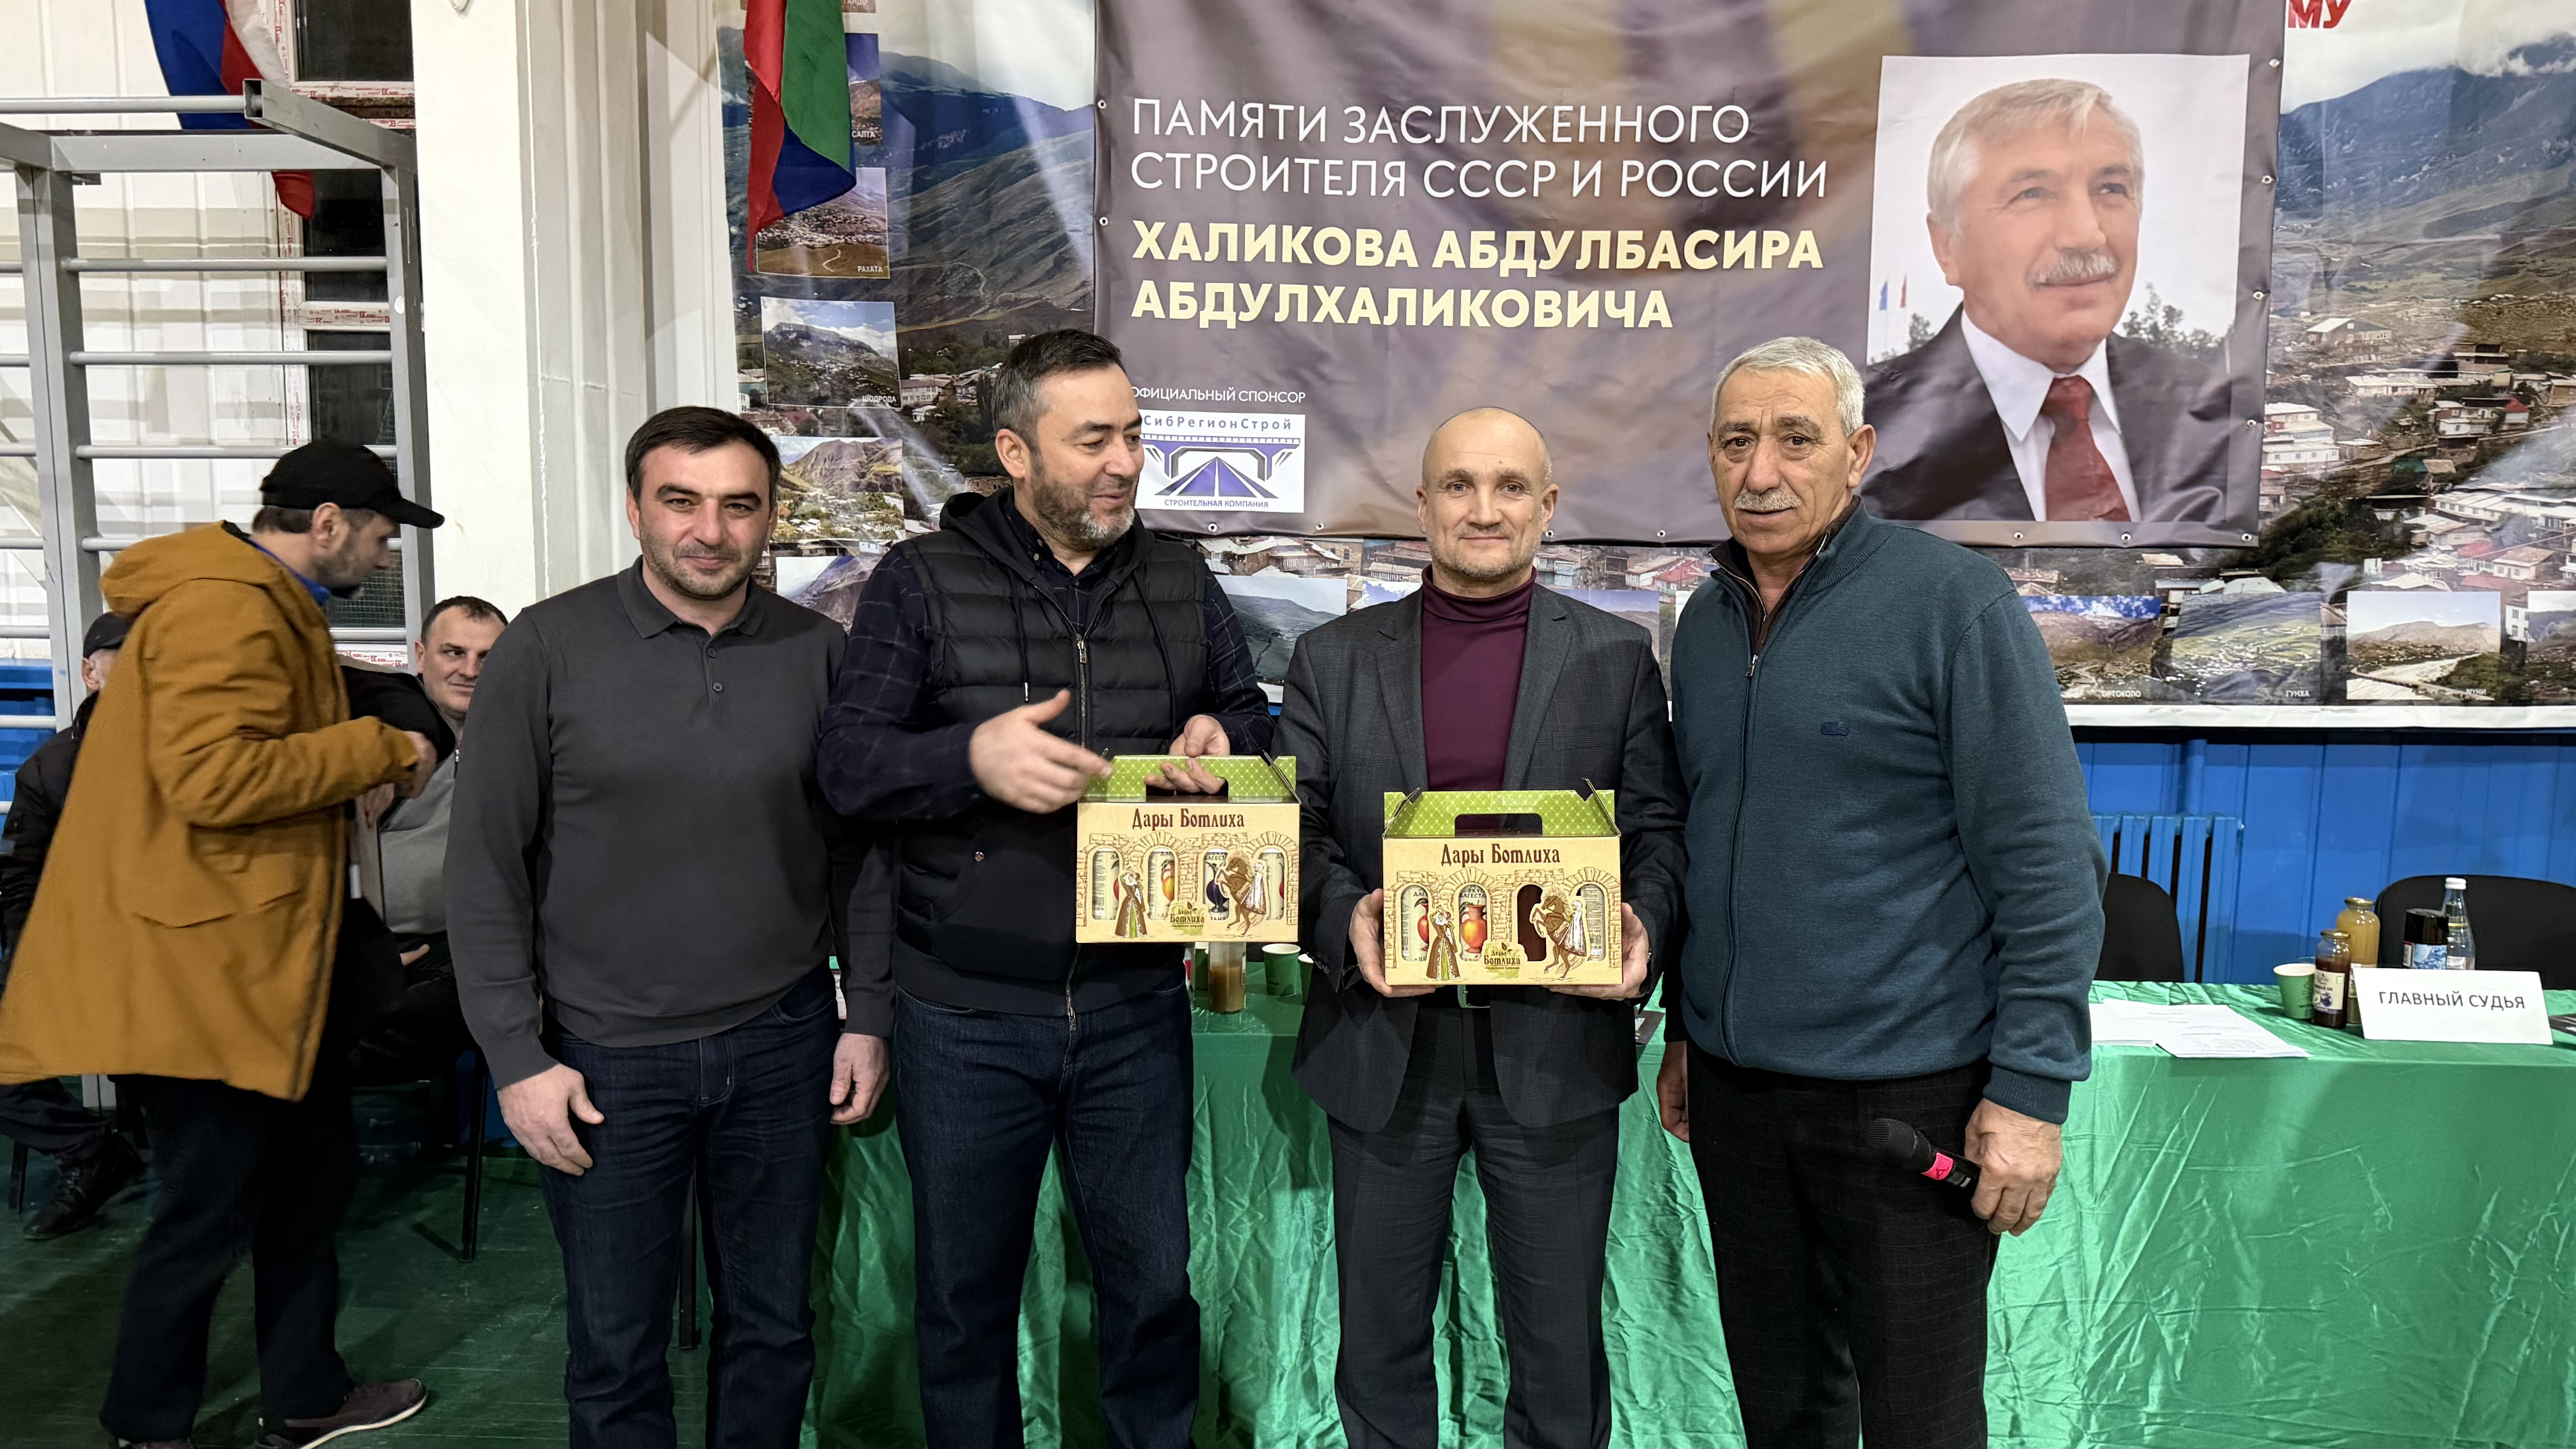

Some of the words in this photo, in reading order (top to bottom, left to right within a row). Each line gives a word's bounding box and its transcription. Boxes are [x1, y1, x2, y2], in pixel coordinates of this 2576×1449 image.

[1134, 97, 1326, 142] ПАМЯТИ
[1343, 105, 1749, 144] ЗАСЛУЖЕННОГО
[1131, 152, 1406, 197] СТРОИТЕЛЯ
[1423, 160, 1556, 198] СССР
[1572, 160, 1602, 198] И
[1620, 159, 1826, 198] РОССИИ
[1132, 220, 1419, 267] ХАЛИКОВА
[1431, 230, 1824, 278] АБДУЛБАСИРА
[1131, 280, 1673, 329] АБДУЛХАЛИКОВИЧА
[862, 395, 897, 404] ШОДРОДА
[1132, 386, 1236, 401] ОФИЦИАЛЬНЫЙ
[1238, 390, 1306, 403] СПОНСОР
[1144, 415, 1292, 432] СибРегионСтрой
[1164, 499, 1223, 507] СТРОИТЕЛЬНАЯ
[1224, 499, 1269, 508] КОМПАНИЯ
[1132, 808, 1173, 831] Дары
[1180, 808, 1245, 827] Ботлиха
[1441, 843, 1484, 868] Дары
[1491, 843, 1560, 863] Ботлиха
[1170, 914, 1205, 923] Ботлиха
[1484, 955, 1521, 965] Ботлиха
[2379, 991, 2463, 1007] ГЛАВНЫЙ
[2469, 995, 2525, 1011] СУДЬЯ
